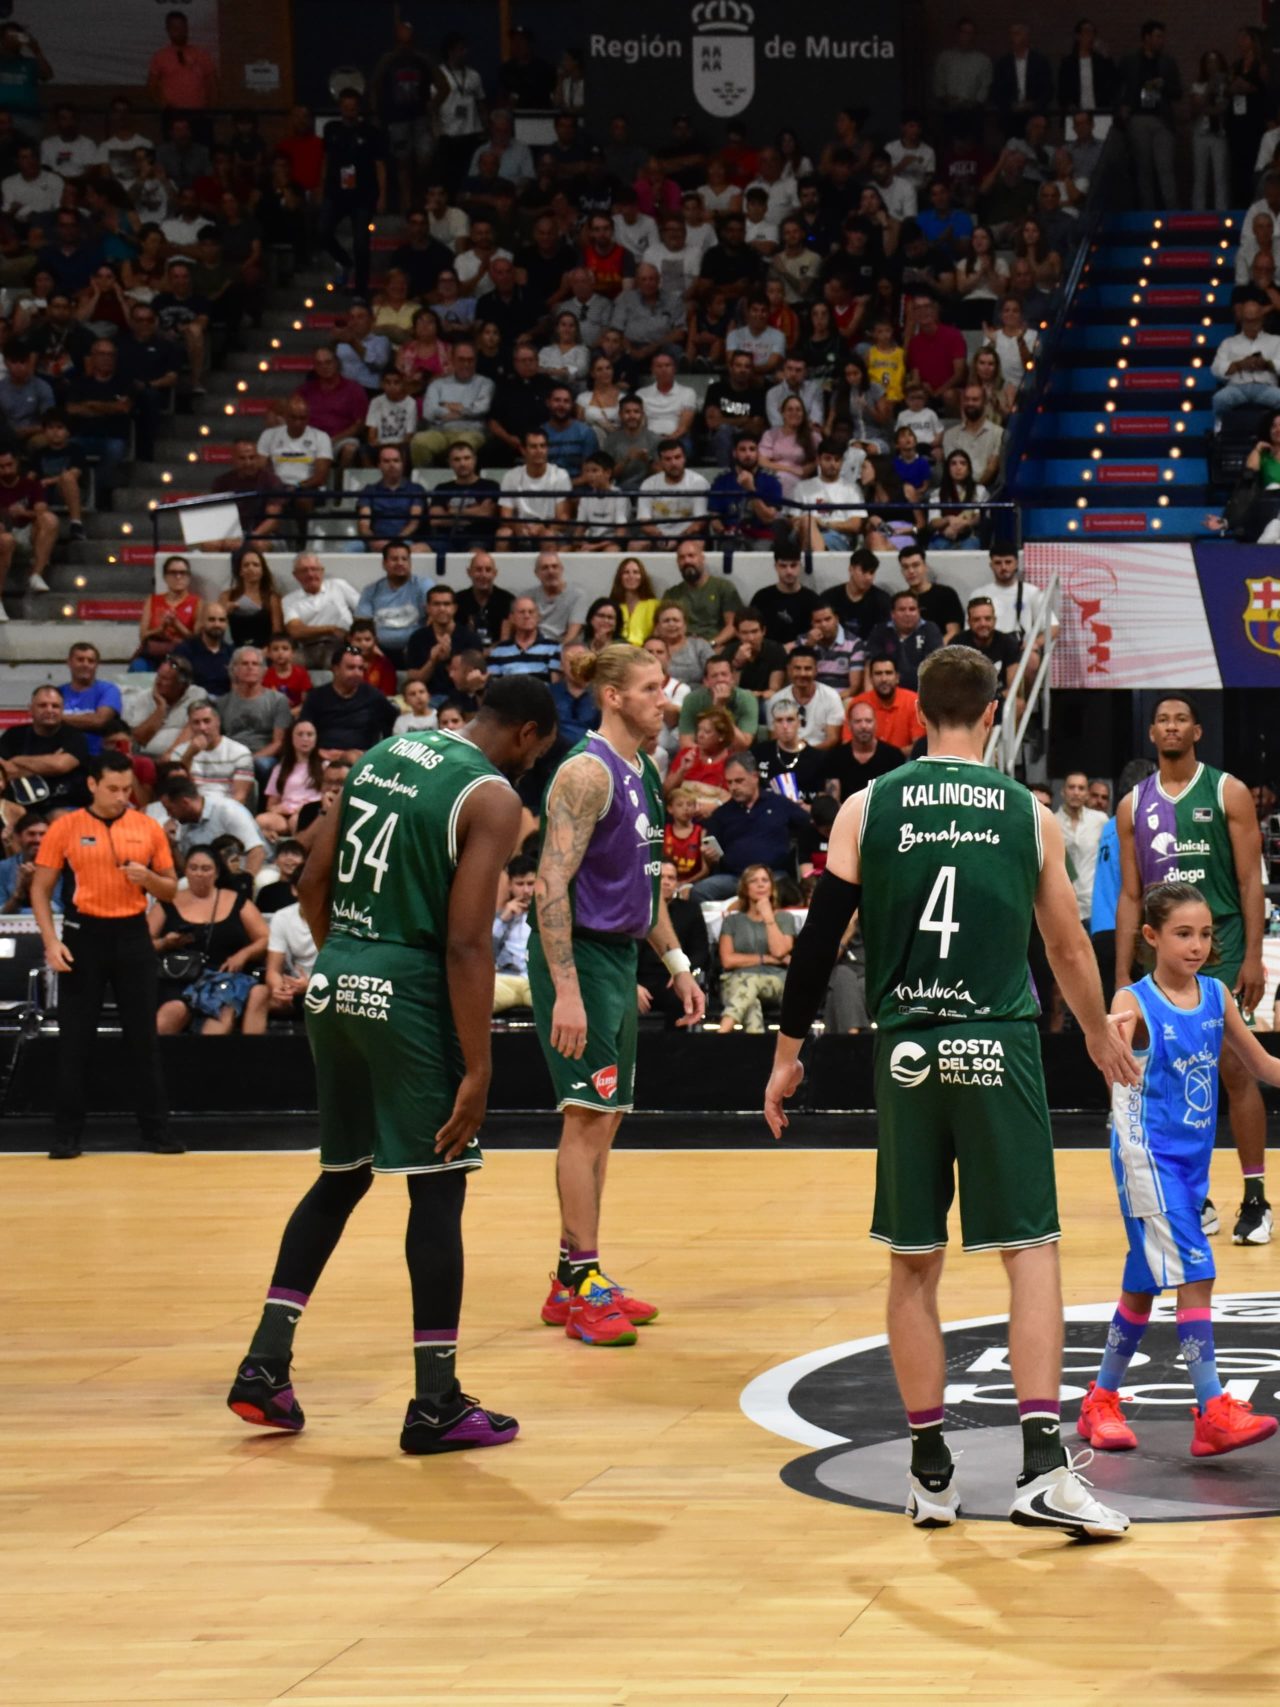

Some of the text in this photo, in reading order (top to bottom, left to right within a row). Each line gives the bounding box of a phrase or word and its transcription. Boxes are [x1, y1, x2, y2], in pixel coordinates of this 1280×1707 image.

[589, 33, 896, 64] Región de Murcia
[388, 737, 445, 770] THOMAS
[902, 783, 1005, 811] KALINOSKI
[338, 796, 400, 894] 34
[1173, 838, 1211, 853] Unicaja
[919, 866, 960, 959] 4
[337, 974, 394, 996] COSTA
[890, 977, 977, 1006] Andalucía
[336, 989, 391, 1009] DEL SOL
[336, 1002, 388, 1021] MÁLAGA
[938, 1039, 1004, 1056] COSTA
[938, 1057, 1004, 1072] DEL SOL
[940, 1070, 1003, 1087] MÁLAGA
